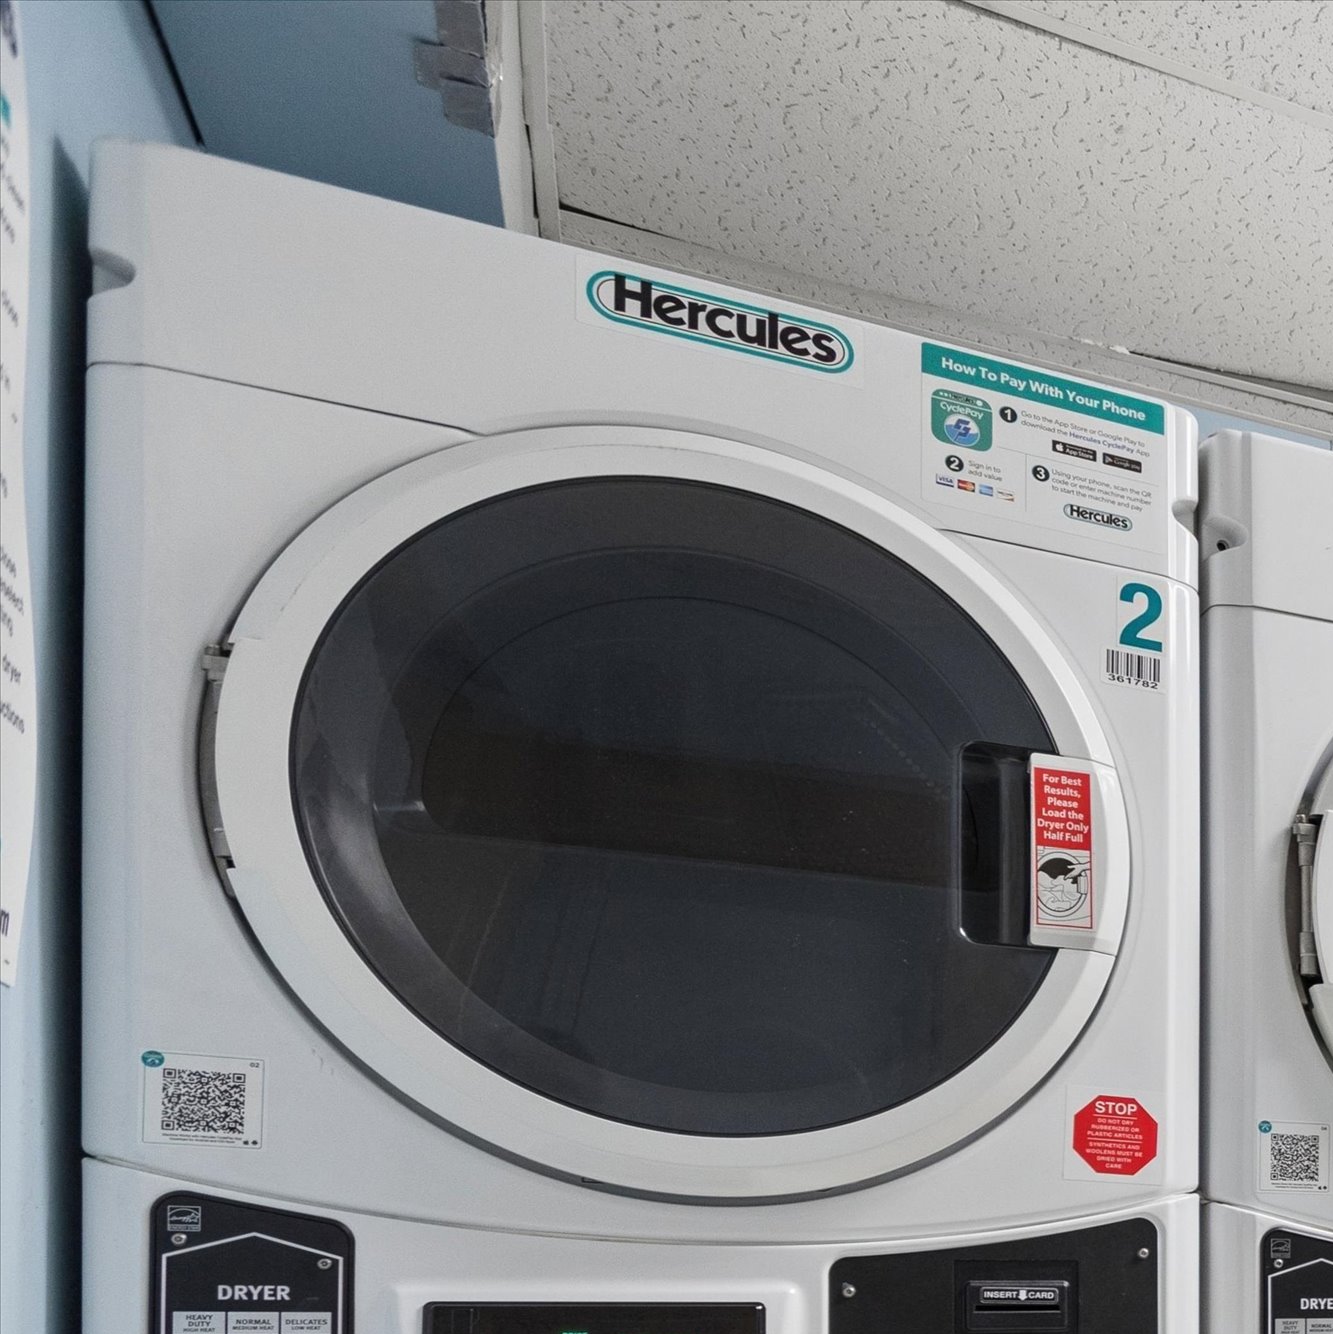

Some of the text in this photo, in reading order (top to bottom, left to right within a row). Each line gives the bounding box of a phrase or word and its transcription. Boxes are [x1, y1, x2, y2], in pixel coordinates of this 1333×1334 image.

[614, 273, 837, 363] Hercules
[941, 356, 1147, 421] How To Pay With Your Phone
[940, 401, 985, 420] CyclePay
[968, 459, 986, 472] Sign
[993, 466, 1001, 474] to
[968, 468, 1003, 482] add value
[1070, 504, 1128, 529] Hercules
[1119, 582, 1163, 652] 2
[1107, 672, 1159, 690] 361782
[1042, 773, 1082, 787] For Best
[1043, 785, 1081, 799] Results,
[1046, 796, 1079, 810] Please
[1041, 808, 1085, 821] Load the
[1037, 819, 1089, 834] Dryer Only
[1043, 830, 1084, 843] Half Full
[1095, 1101, 1137, 1116] STOP
[216, 1284, 291, 1301] DRYER
[983, 1291, 1055, 1300] INSERT CARD
[235, 1318, 328, 1326] NORMAL DELICATES
